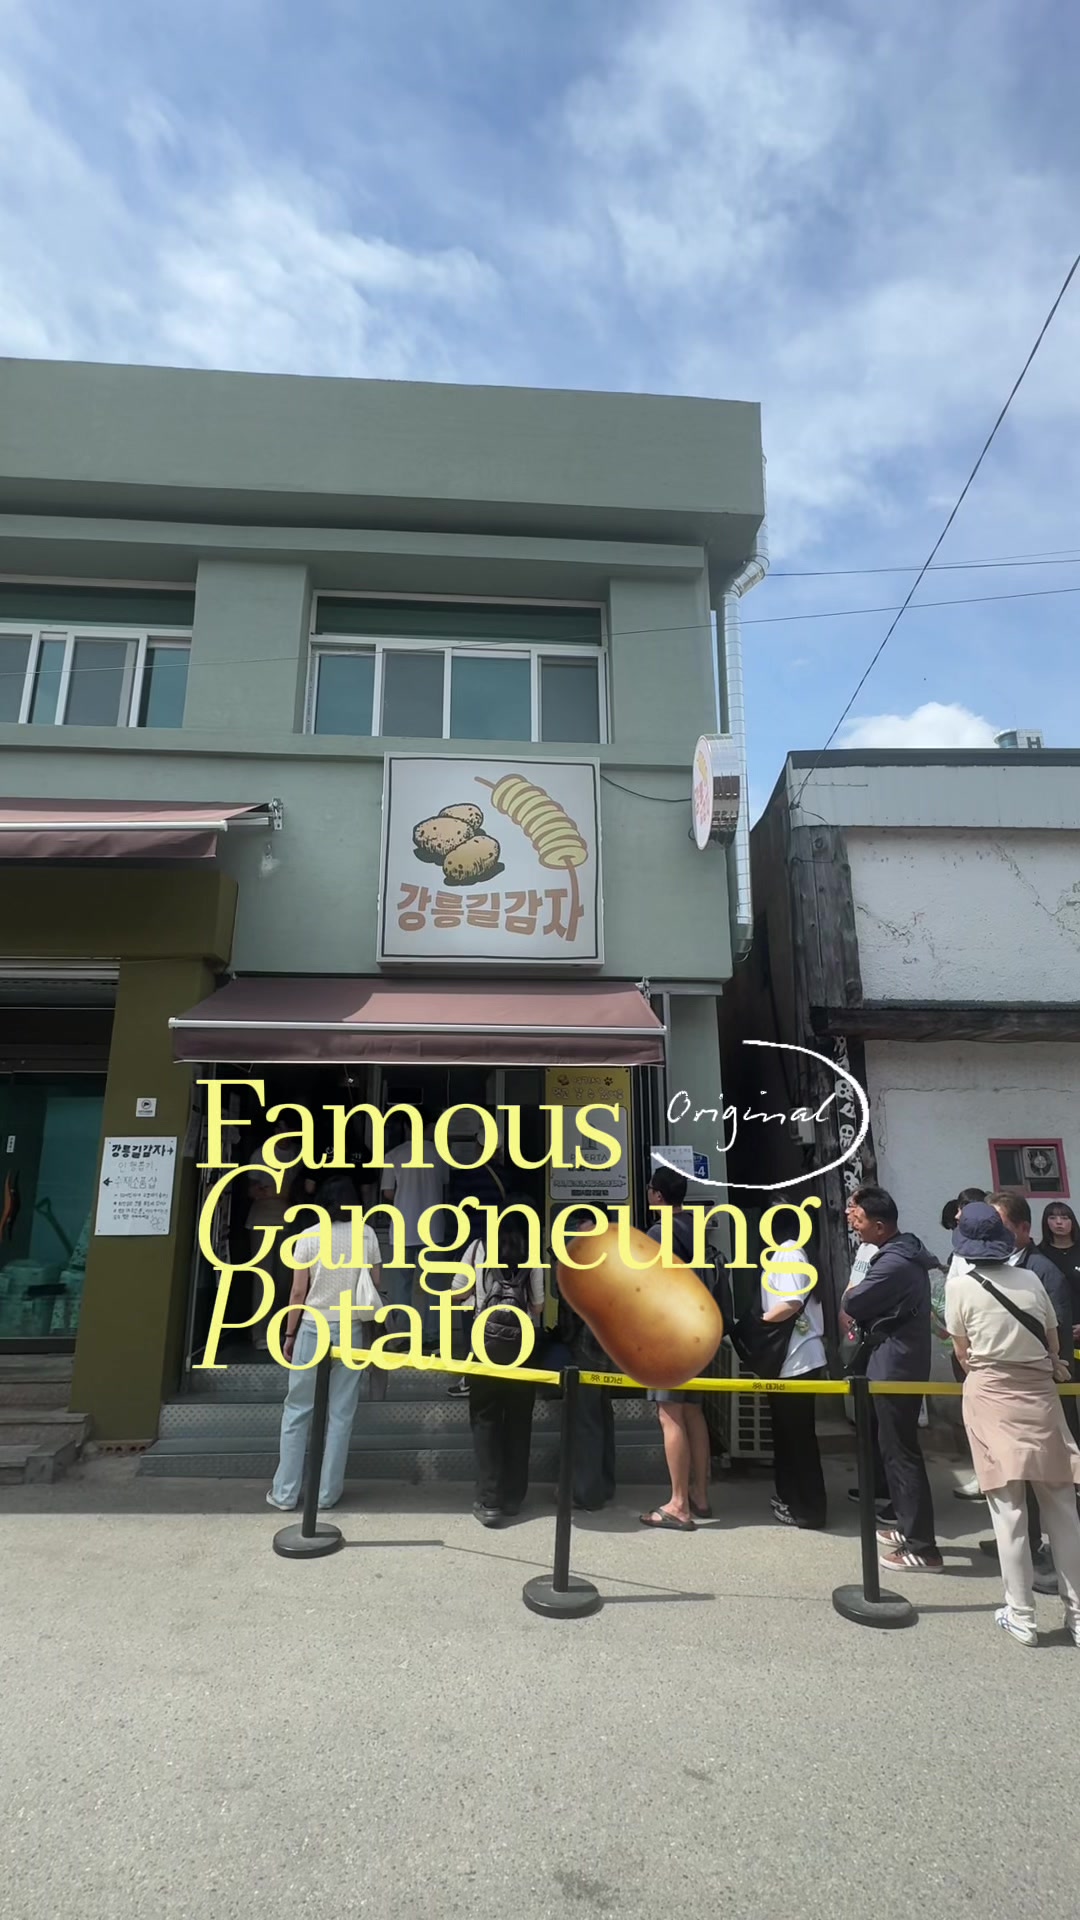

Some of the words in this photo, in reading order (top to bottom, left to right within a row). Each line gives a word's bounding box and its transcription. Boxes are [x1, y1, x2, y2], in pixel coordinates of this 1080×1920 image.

[1026, 736, 1042, 749] H
[397, 882, 584, 942] 강릉길감자
[111, 1144, 166, 1158] 강릉길감자
[570, 1153, 608, 1161] PERTA
[603, 1375, 623, 1384] 대기선
[765, 1383, 786, 1391] 대기선
